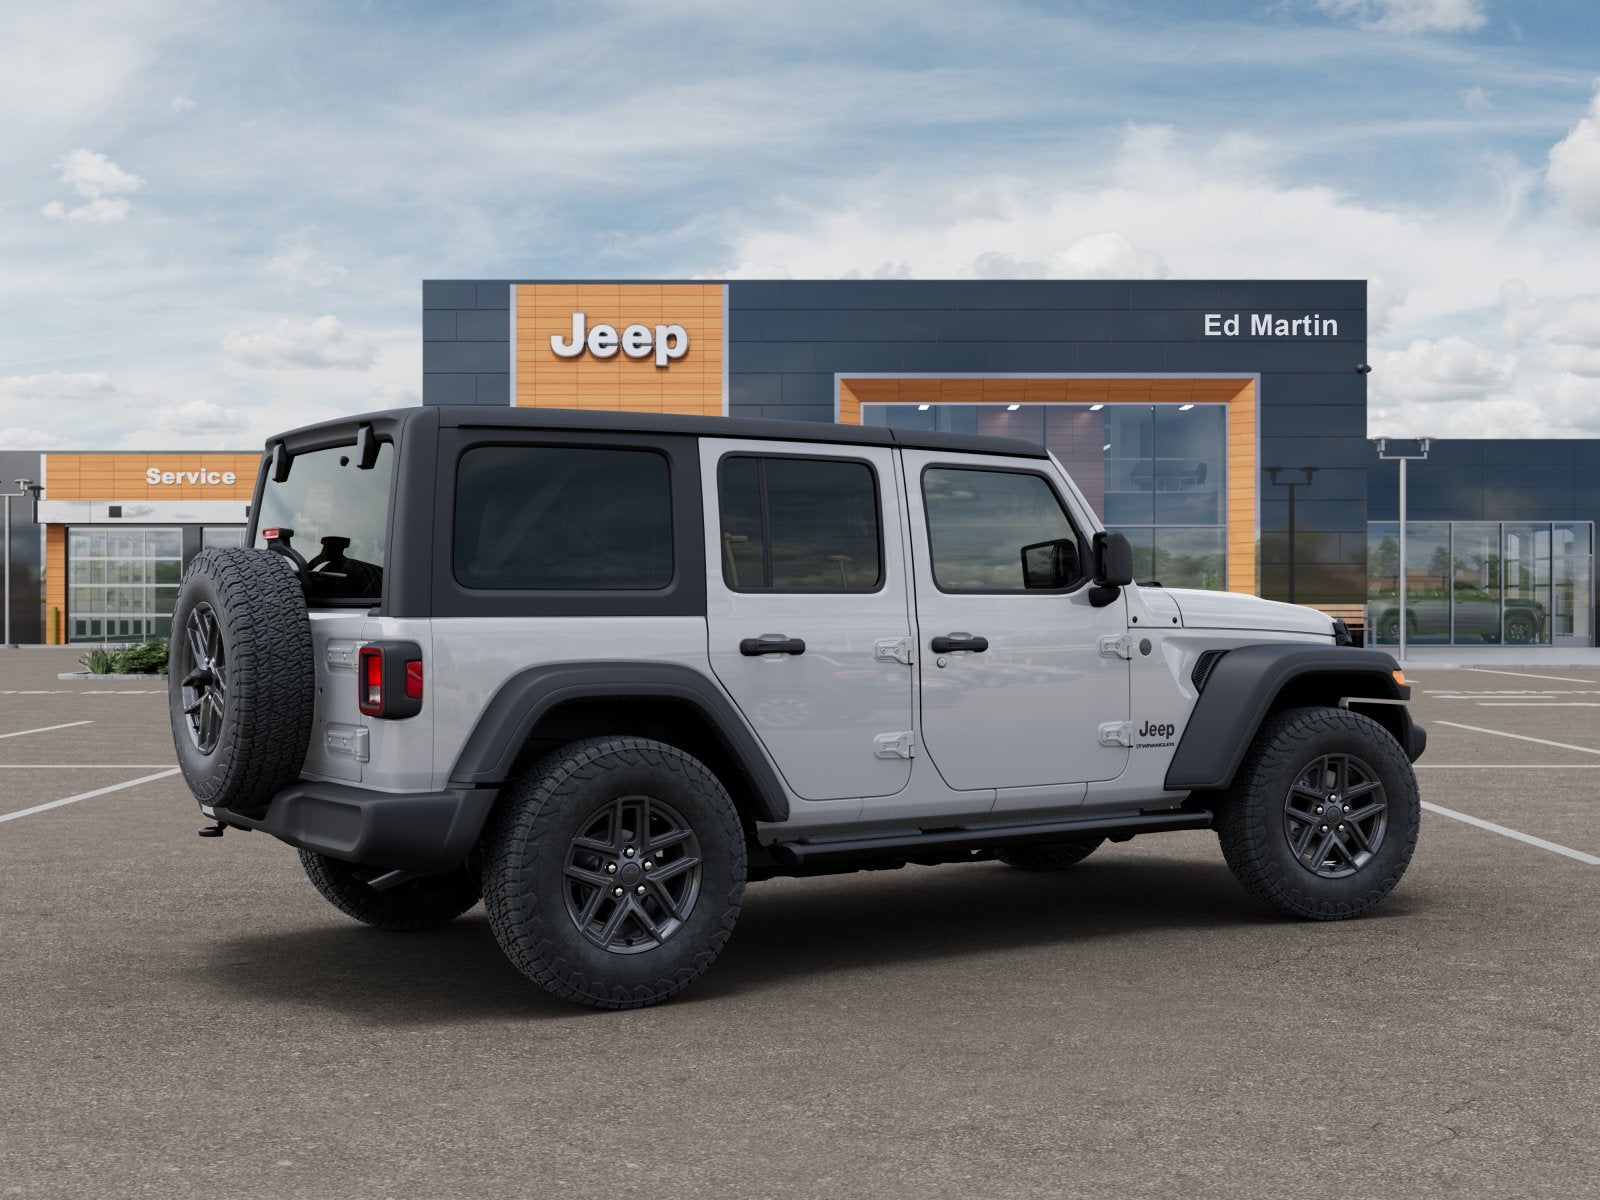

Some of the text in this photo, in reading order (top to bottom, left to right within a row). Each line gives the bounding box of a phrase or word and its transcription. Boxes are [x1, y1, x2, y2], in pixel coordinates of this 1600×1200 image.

[1204, 313, 1338, 336] Ed Martin
[550, 312, 689, 367] Jeep
[145, 467, 237, 485] Service
[1139, 720, 1175, 739] Jeep
